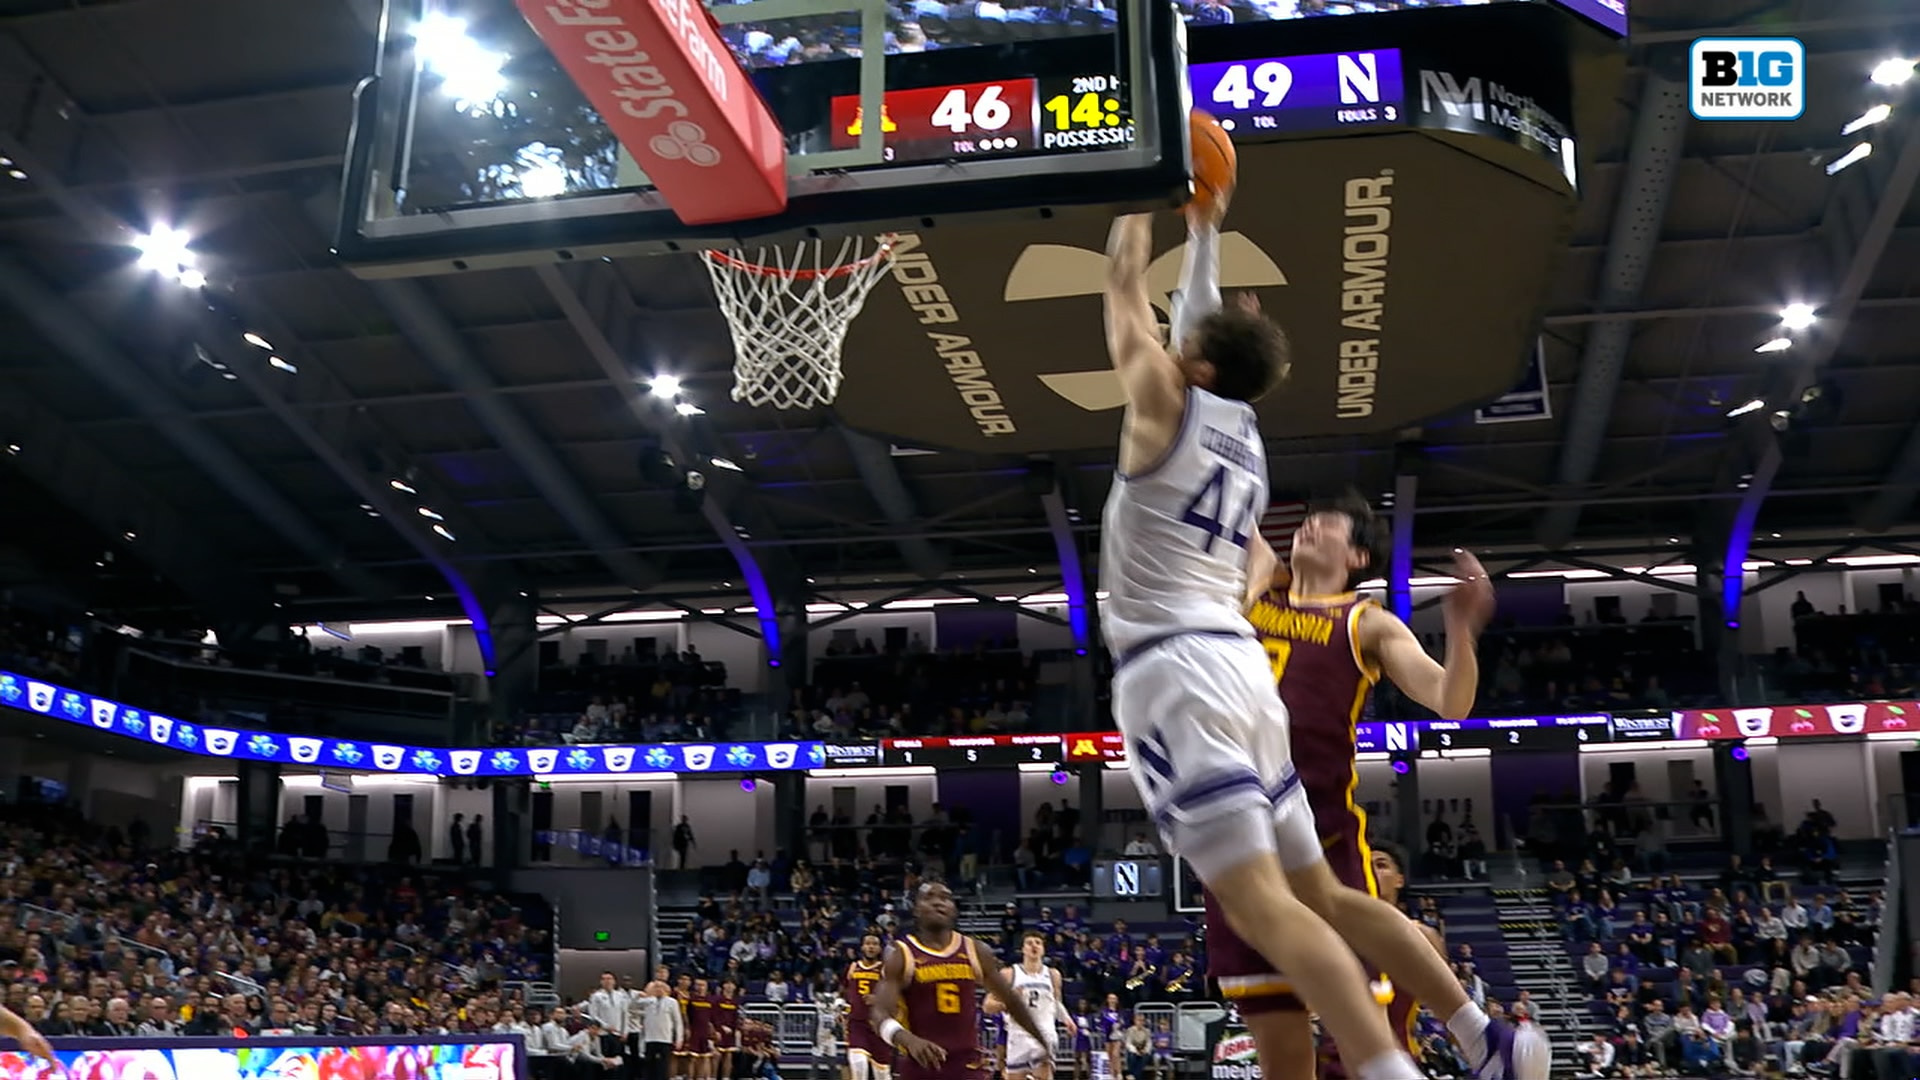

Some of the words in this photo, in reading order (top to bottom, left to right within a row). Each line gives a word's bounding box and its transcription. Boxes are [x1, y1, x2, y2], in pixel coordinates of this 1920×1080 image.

[1072, 76, 1107, 94] 2ND
[1212, 61, 1293, 109] 49
[1337, 53, 1379, 104] N
[931, 86, 1012, 133] 46
[1045, 93, 1135, 130] 14:
[1337, 108, 1378, 123] FOULS
[1384, 105, 1397, 121] 3
[884, 147, 895, 161] 3
[1341, 176, 1394, 331] ARMOUR
[874, 231, 959, 324] NDER
[926, 332, 1016, 437] ARMOUR
[1336, 339, 1380, 418] UNDER
[1385, 722, 1408, 750] N
[1440, 733, 1451, 746] 3
[1508, 731, 1520, 744] 2
[967, 749, 977, 762] 5
[1031, 747, 1042, 760] 2
[858, 980, 870, 995] 5
[936, 982, 961, 1014] 6
[1212, 1060, 1263, 1080] meije
